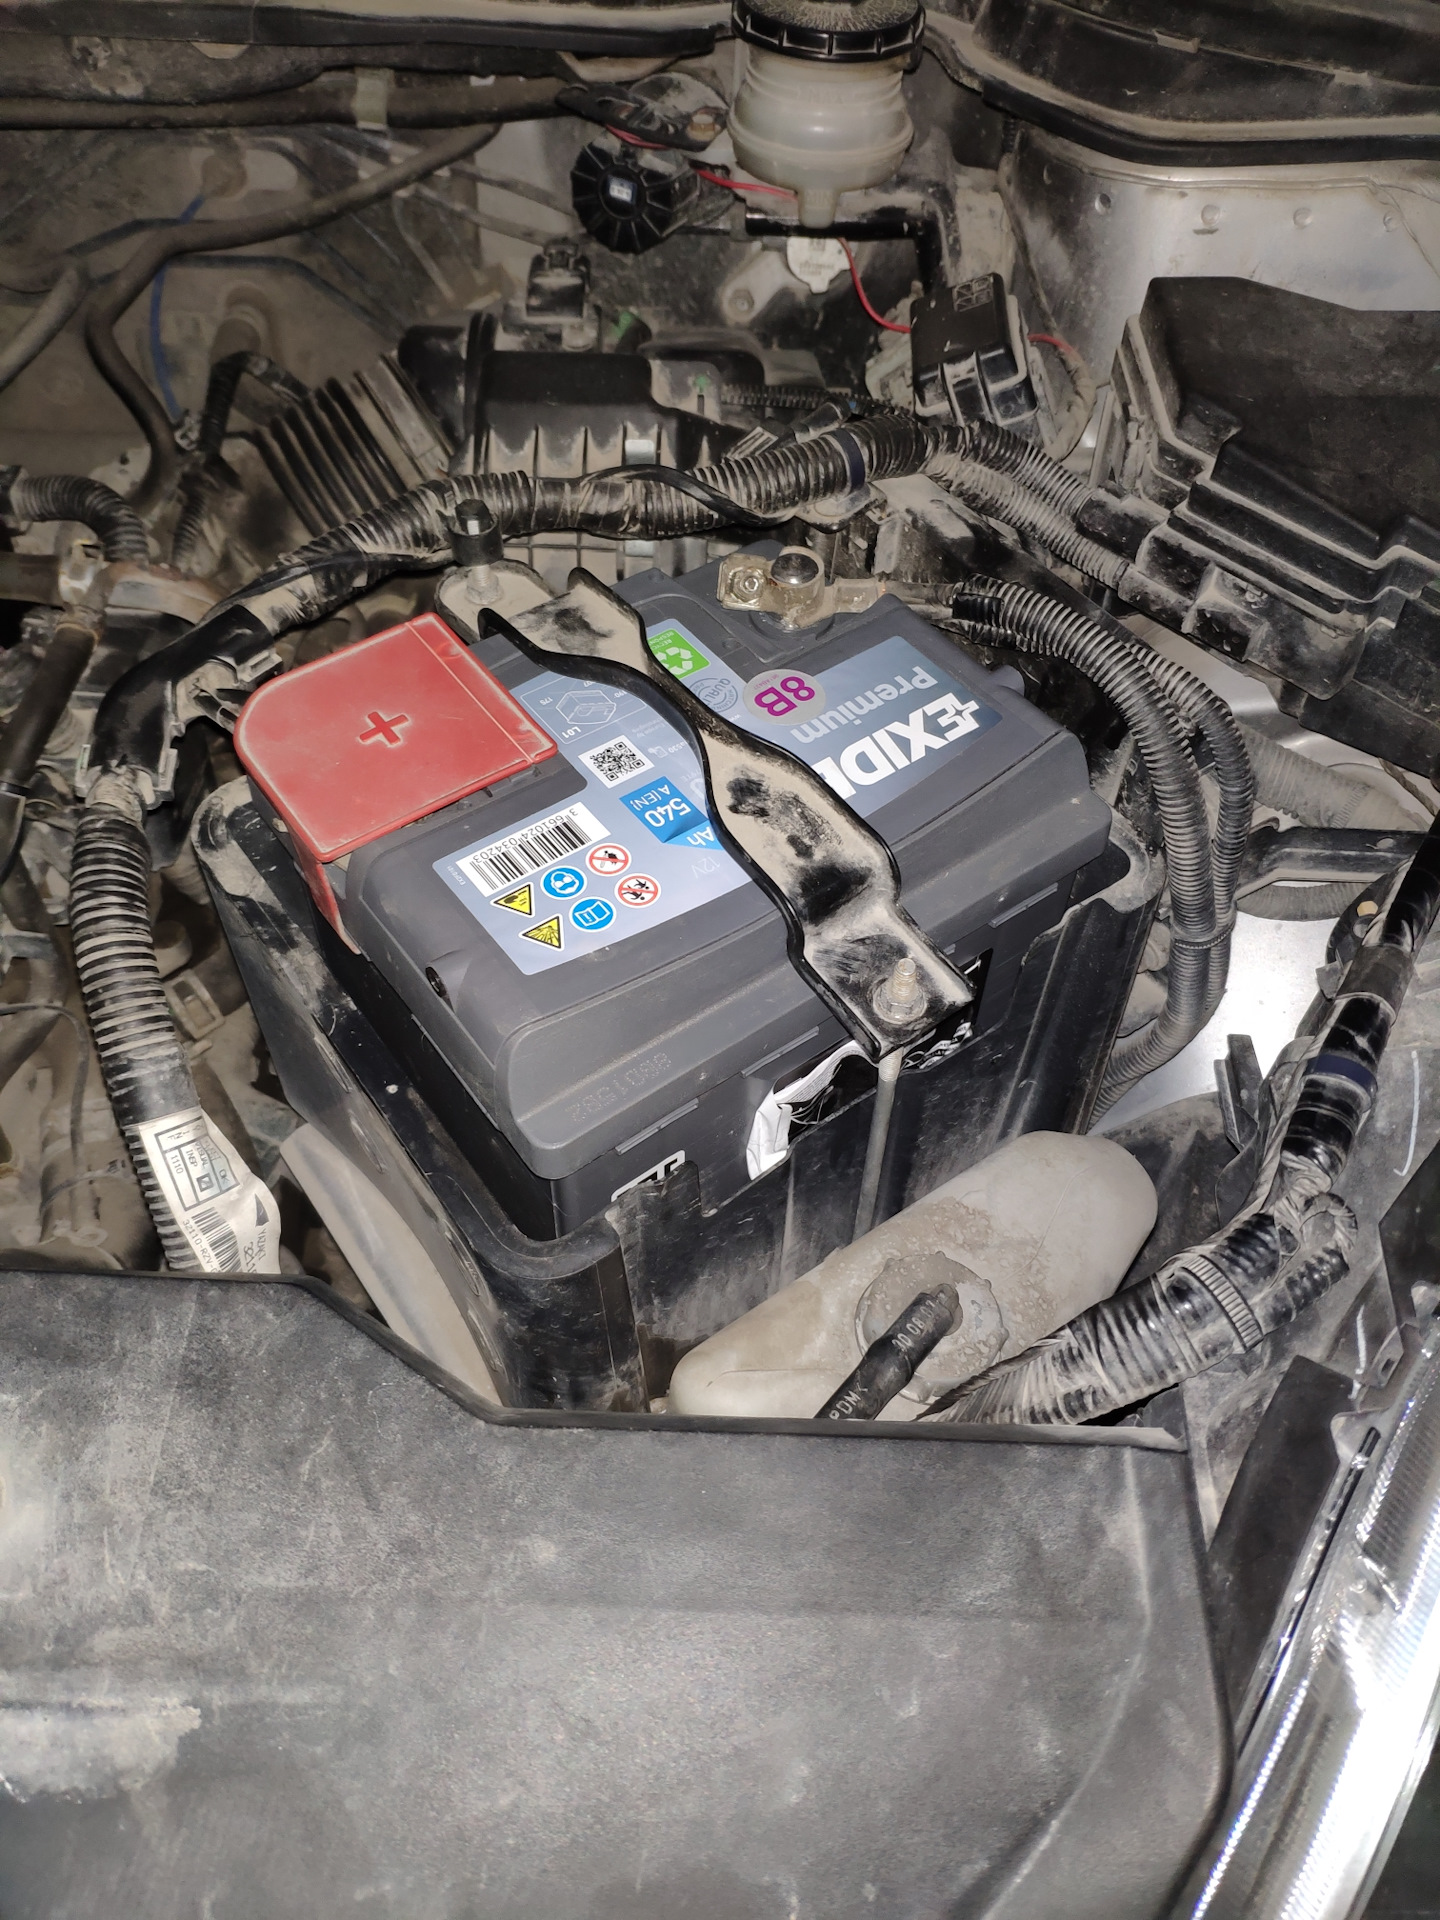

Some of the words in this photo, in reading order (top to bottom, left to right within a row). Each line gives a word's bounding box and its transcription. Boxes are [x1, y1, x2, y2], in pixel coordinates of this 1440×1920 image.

[539, 696, 553, 706] 175
[754, 676, 815, 715] 8B
[789, 665, 938, 744] Premium
[561, 725, 582, 738] L01
[630, 790, 661, 811] (EN)
[657, 784, 670, 795] A
[568, 807, 577, 818] 3
[643, 796, 691, 829] 540
[519, 814, 564, 840] 661024
[686, 825, 714, 849] Ah
[471, 837, 517, 863] 034203
[690, 856, 721, 879] 12V
[171, 1154, 184, 1174] 1110
[219, 1168, 230, 1185] OK
